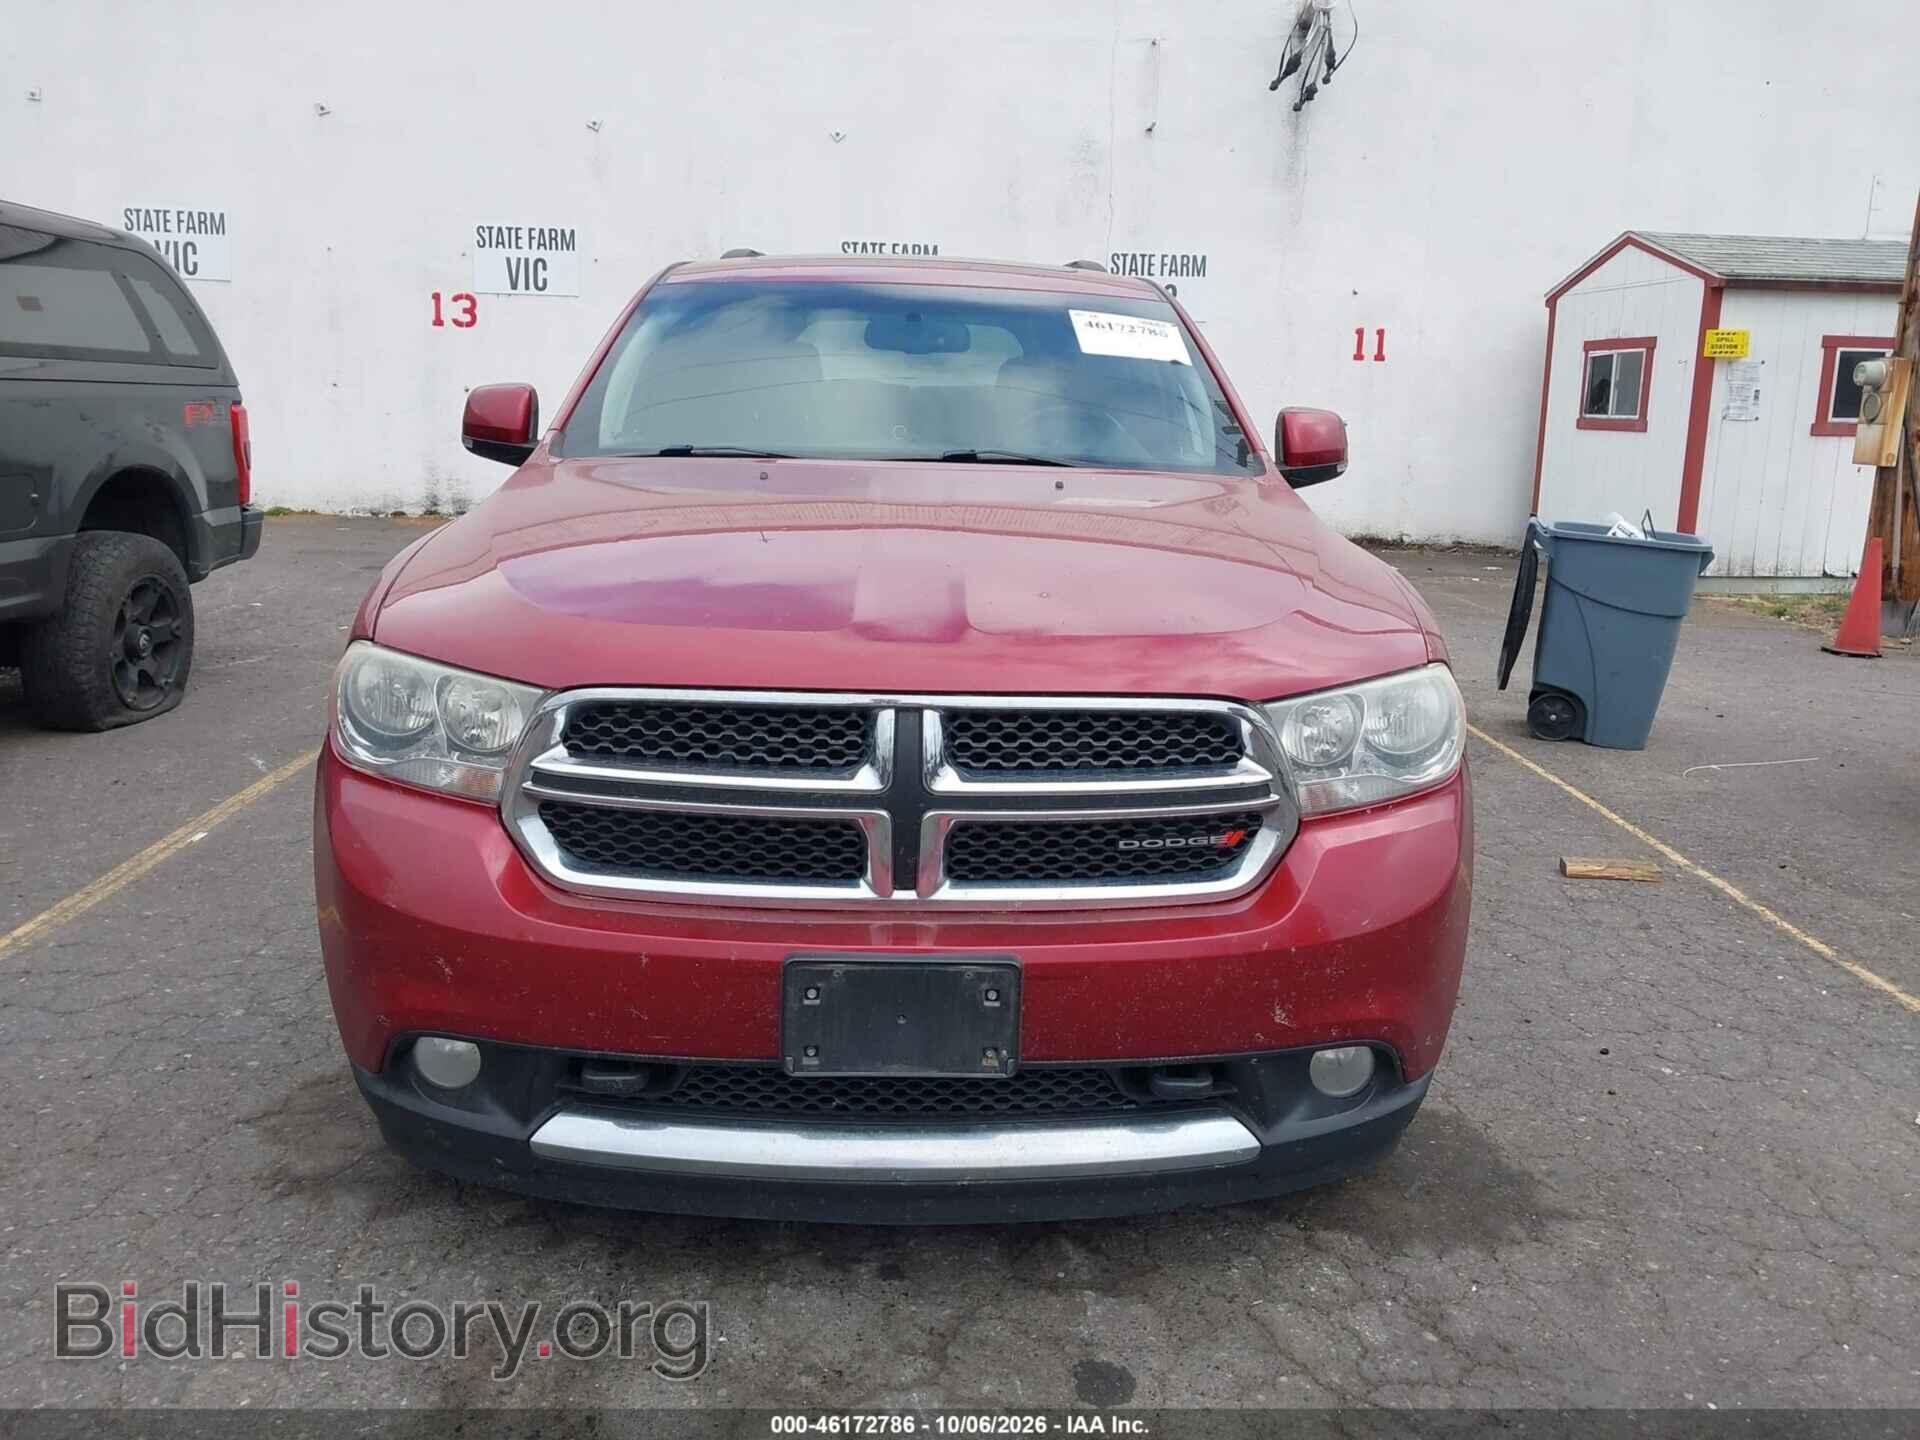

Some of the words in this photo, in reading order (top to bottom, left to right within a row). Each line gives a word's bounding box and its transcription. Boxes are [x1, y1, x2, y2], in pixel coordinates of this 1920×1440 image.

[124, 208, 172, 233] STATE
[176, 210, 226, 236] FARM
[476, 225, 524, 250] STATE
[528, 227, 576, 252] FARM
[505, 256, 549, 291] VIC
[1110, 253, 1156, 277] STATE
[1159, 254, 1207, 278] FARM
[431, 291, 478, 328] 13
[1353, 327, 1386, 363] 11
[1118, 835, 1226, 849] DODGE
